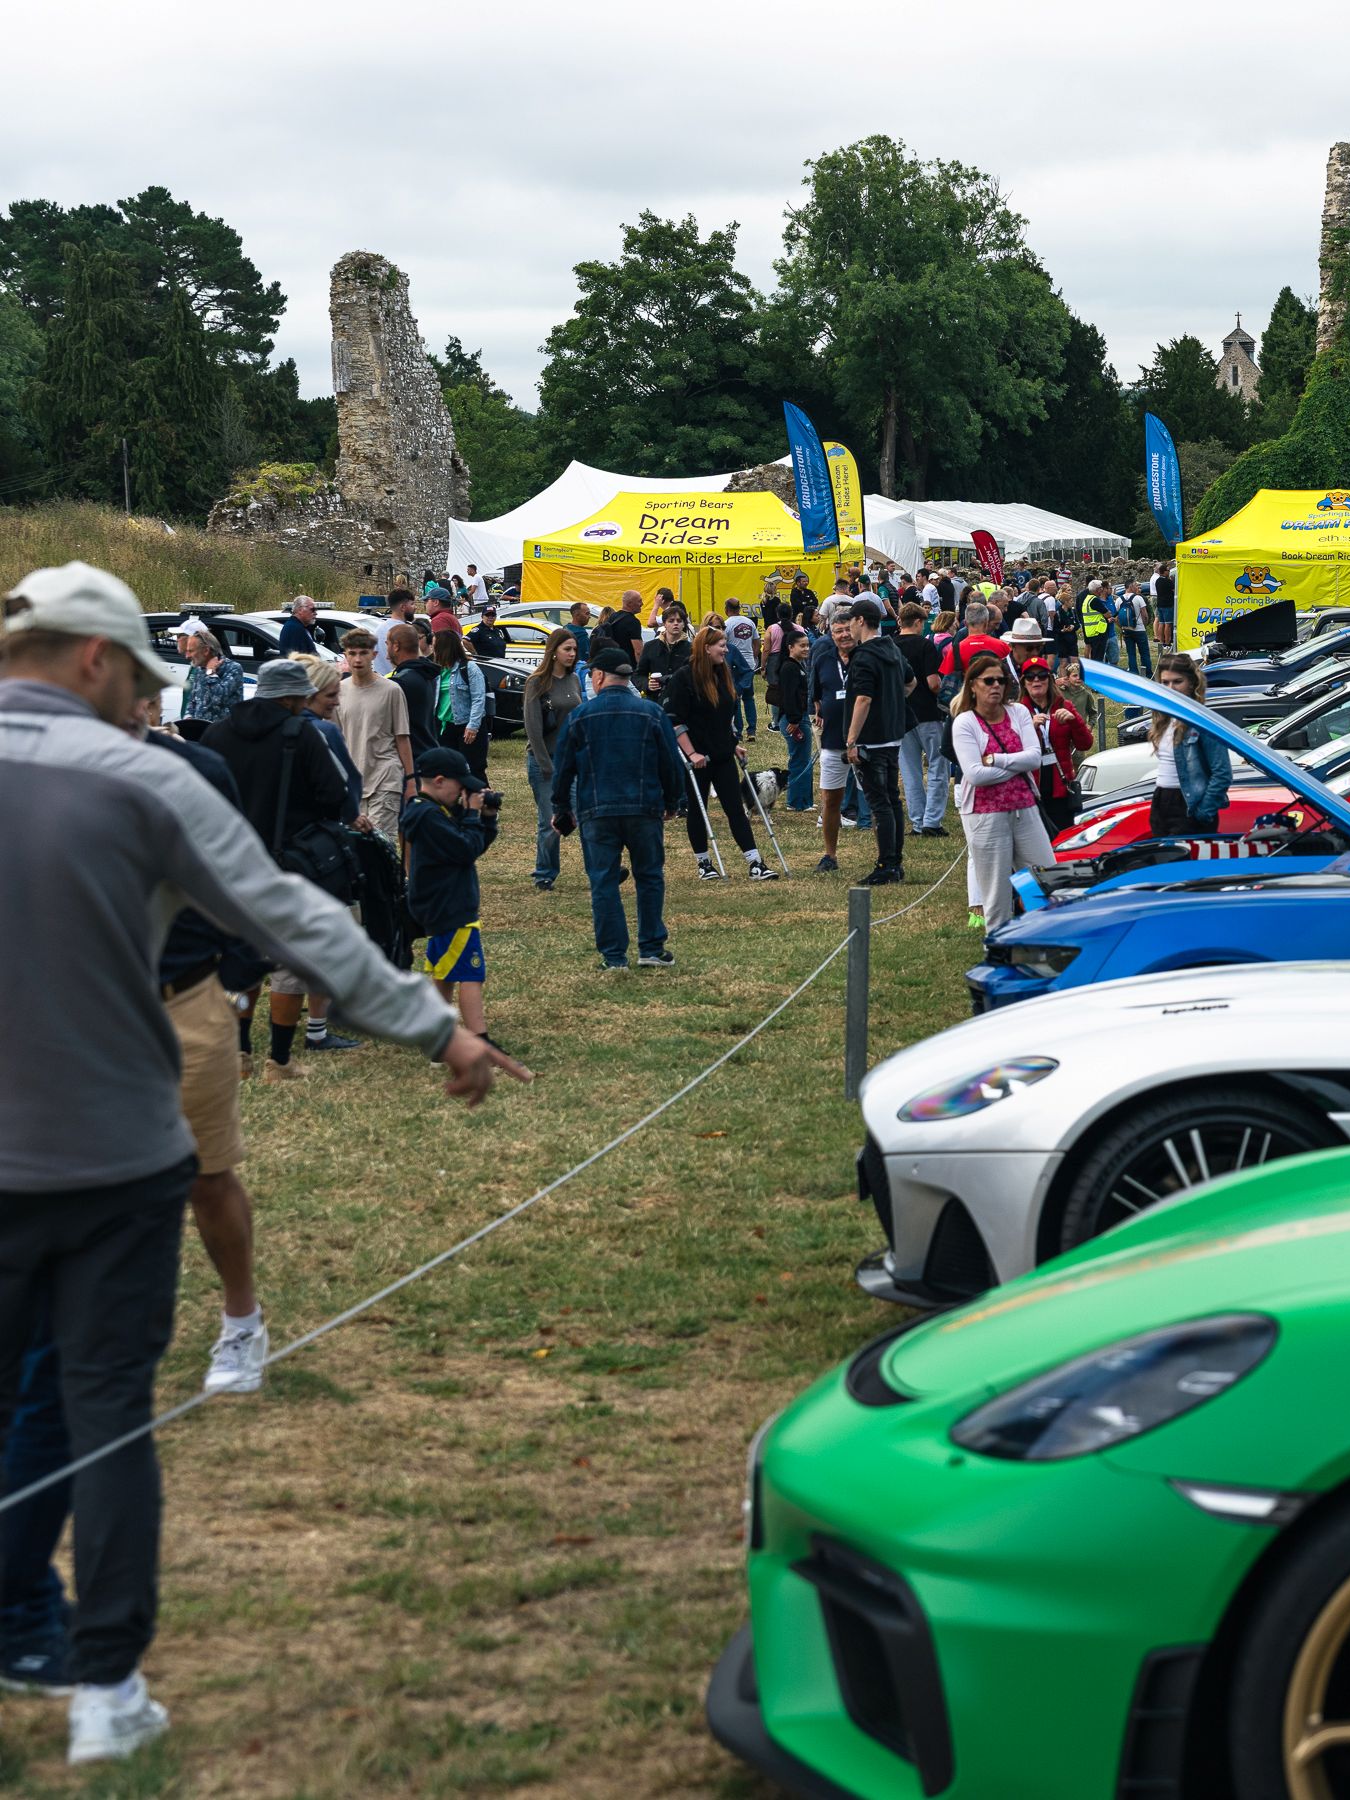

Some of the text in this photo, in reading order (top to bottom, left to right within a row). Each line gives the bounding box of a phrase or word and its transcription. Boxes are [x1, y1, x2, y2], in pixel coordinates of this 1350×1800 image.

[795, 445, 811, 509] BRIDGESTONE
[1151, 452, 1162, 511] BRIDGESTONE
[644, 499, 734, 510] Sporting Bears
[638, 513, 730, 530] Dream
[1308, 511, 1344, 519] Sporting
[1280, 518, 1342, 531] DREAM
[640, 531, 719, 545] Rides
[602, 550, 763, 564] Book Dream Rides Here!
[1281, 551, 1303, 560] Book
[1305, 552, 1335, 560] Dream
[1225, 595, 1264, 606] Sporting
